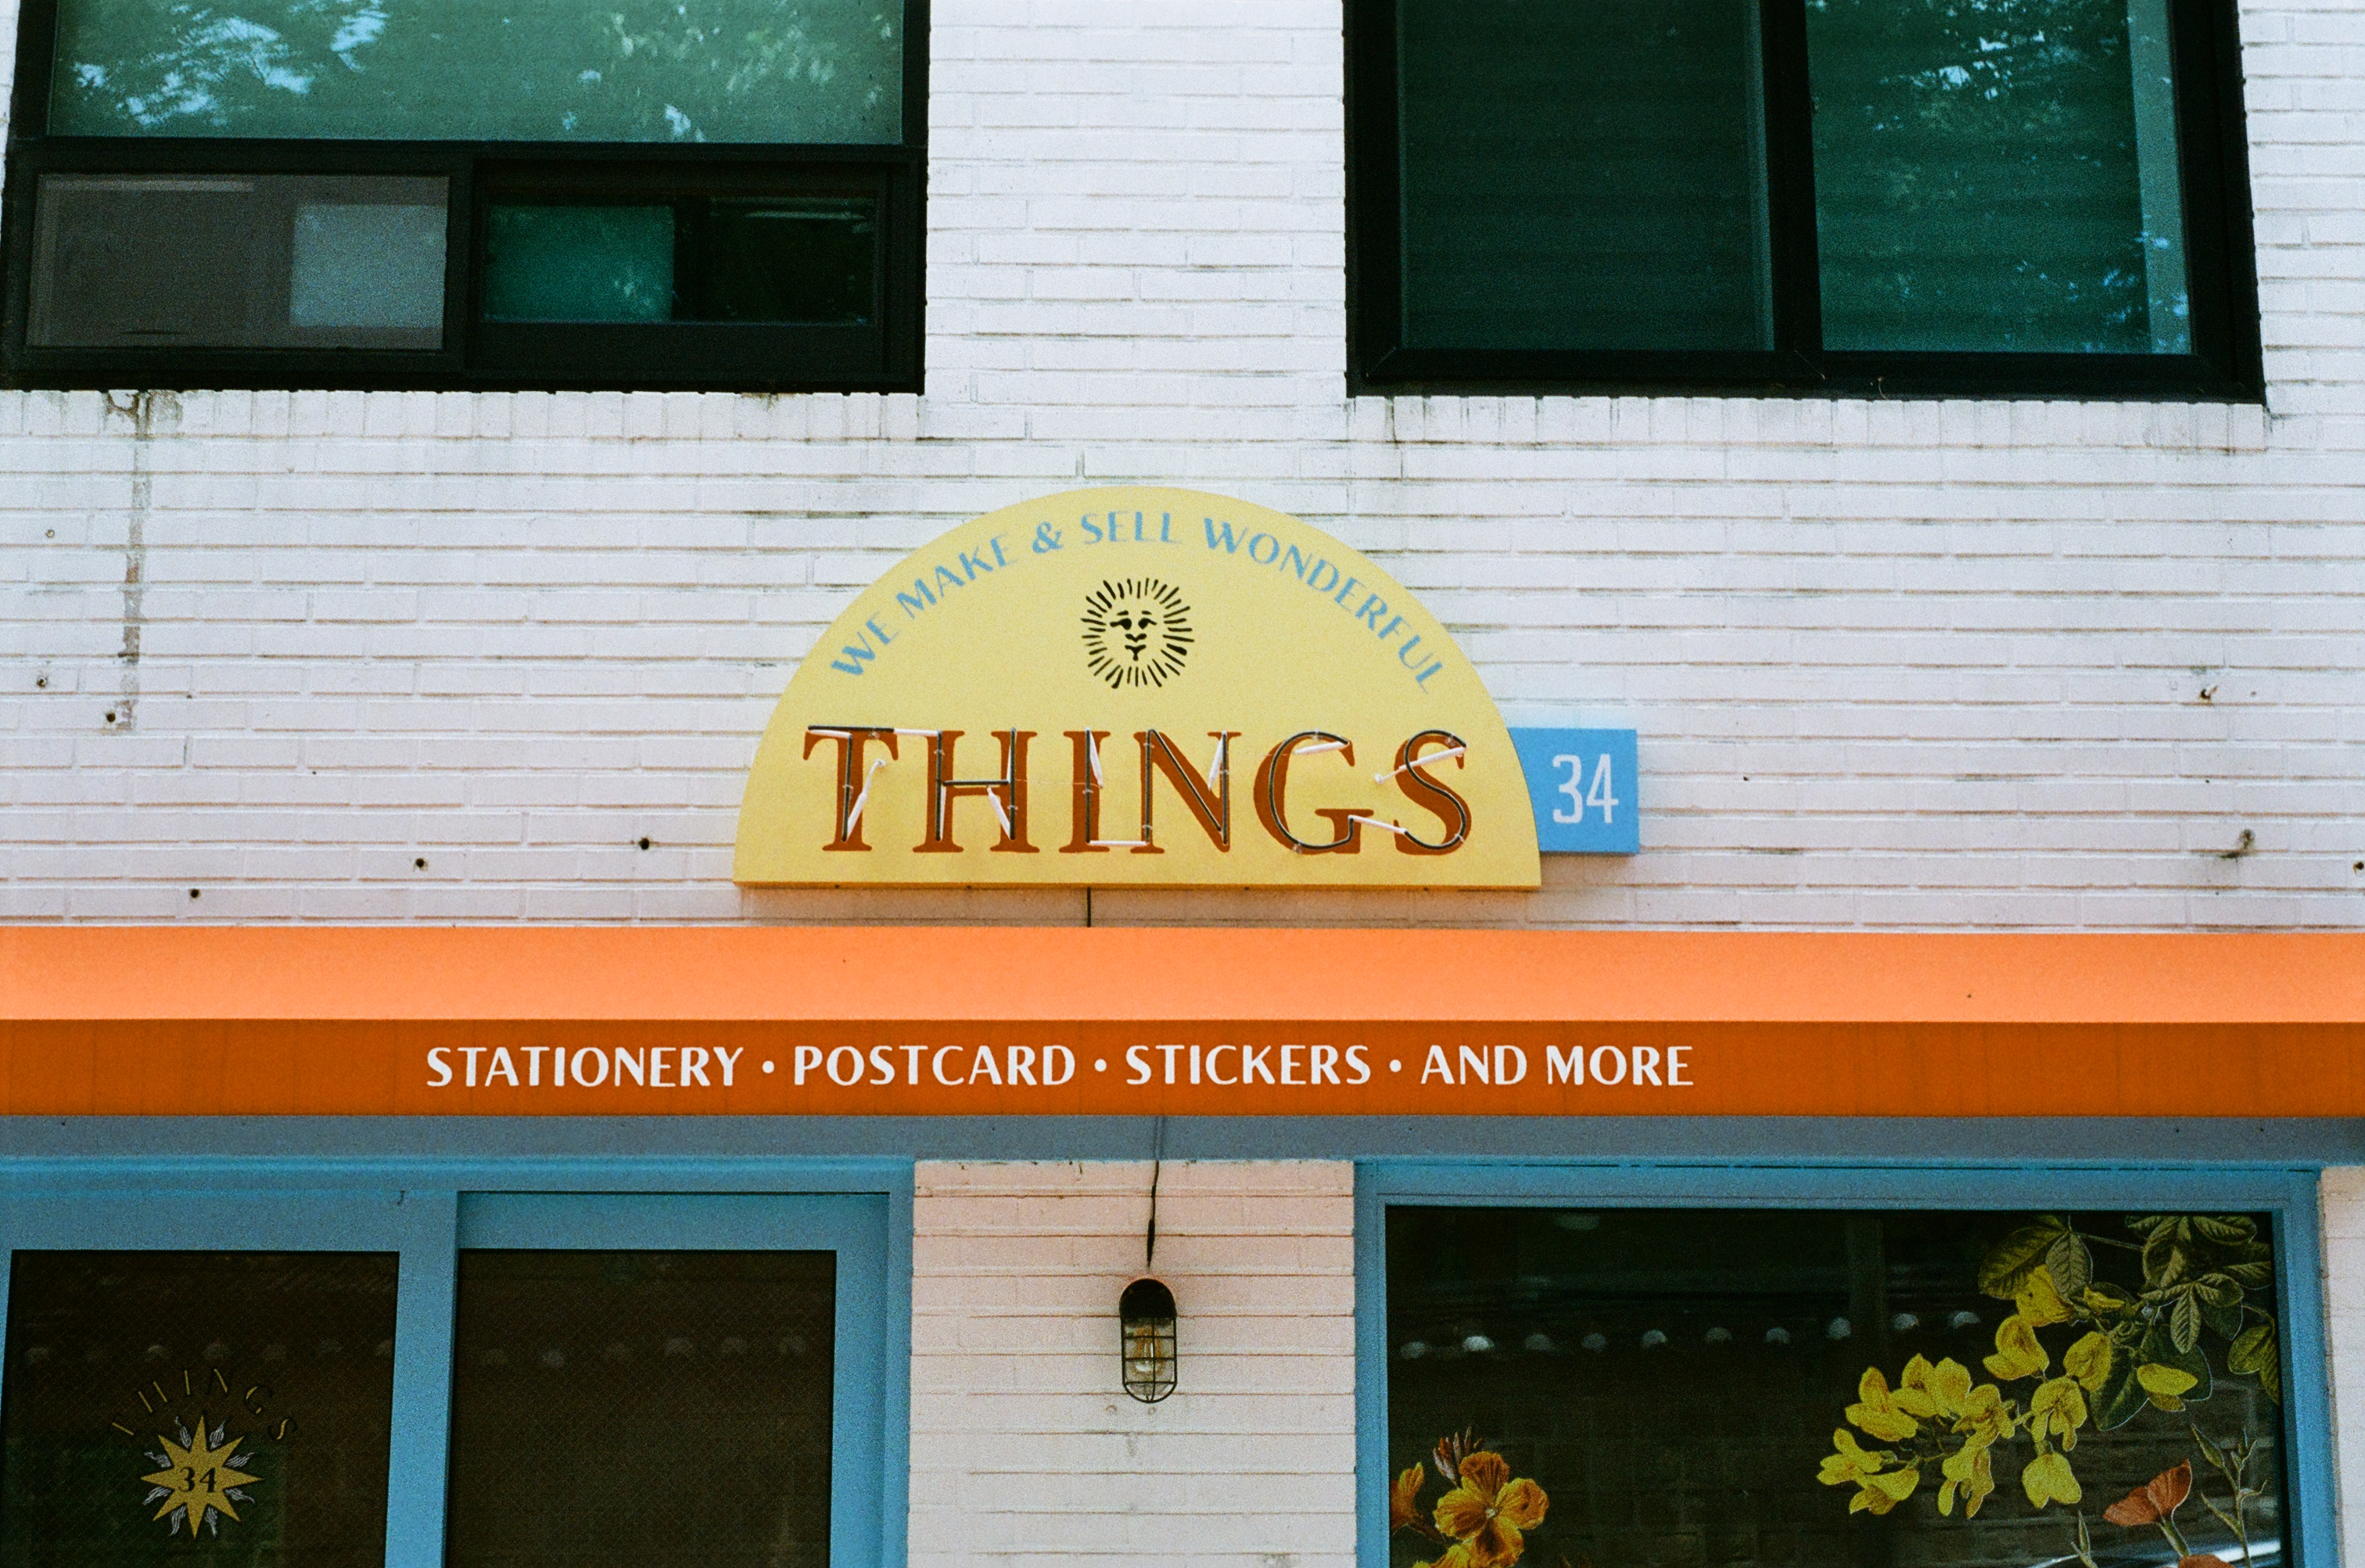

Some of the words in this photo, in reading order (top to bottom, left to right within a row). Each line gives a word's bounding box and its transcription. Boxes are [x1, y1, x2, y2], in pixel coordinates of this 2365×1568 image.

[830, 611, 899, 676] WE
[895, 532, 1017, 619] MAKE
[1031, 521, 1065, 555] &
[1080, 509, 1183, 545] SELL
[1203, 516, 1444, 694] WONDERFUL
[803, 725, 1472, 856] THINGS
[1552, 754, 1619, 823] 34
[427, 1046, 743, 1087] STATIONERY
[794, 1045, 1075, 1086] POSTCARD
[1125, 1045, 1371, 1085] STICKERS
[1421, 1045, 1527, 1085] AND
[1546, 1045, 1692, 1086] MORE
[178, 1466, 217, 1494] 34
